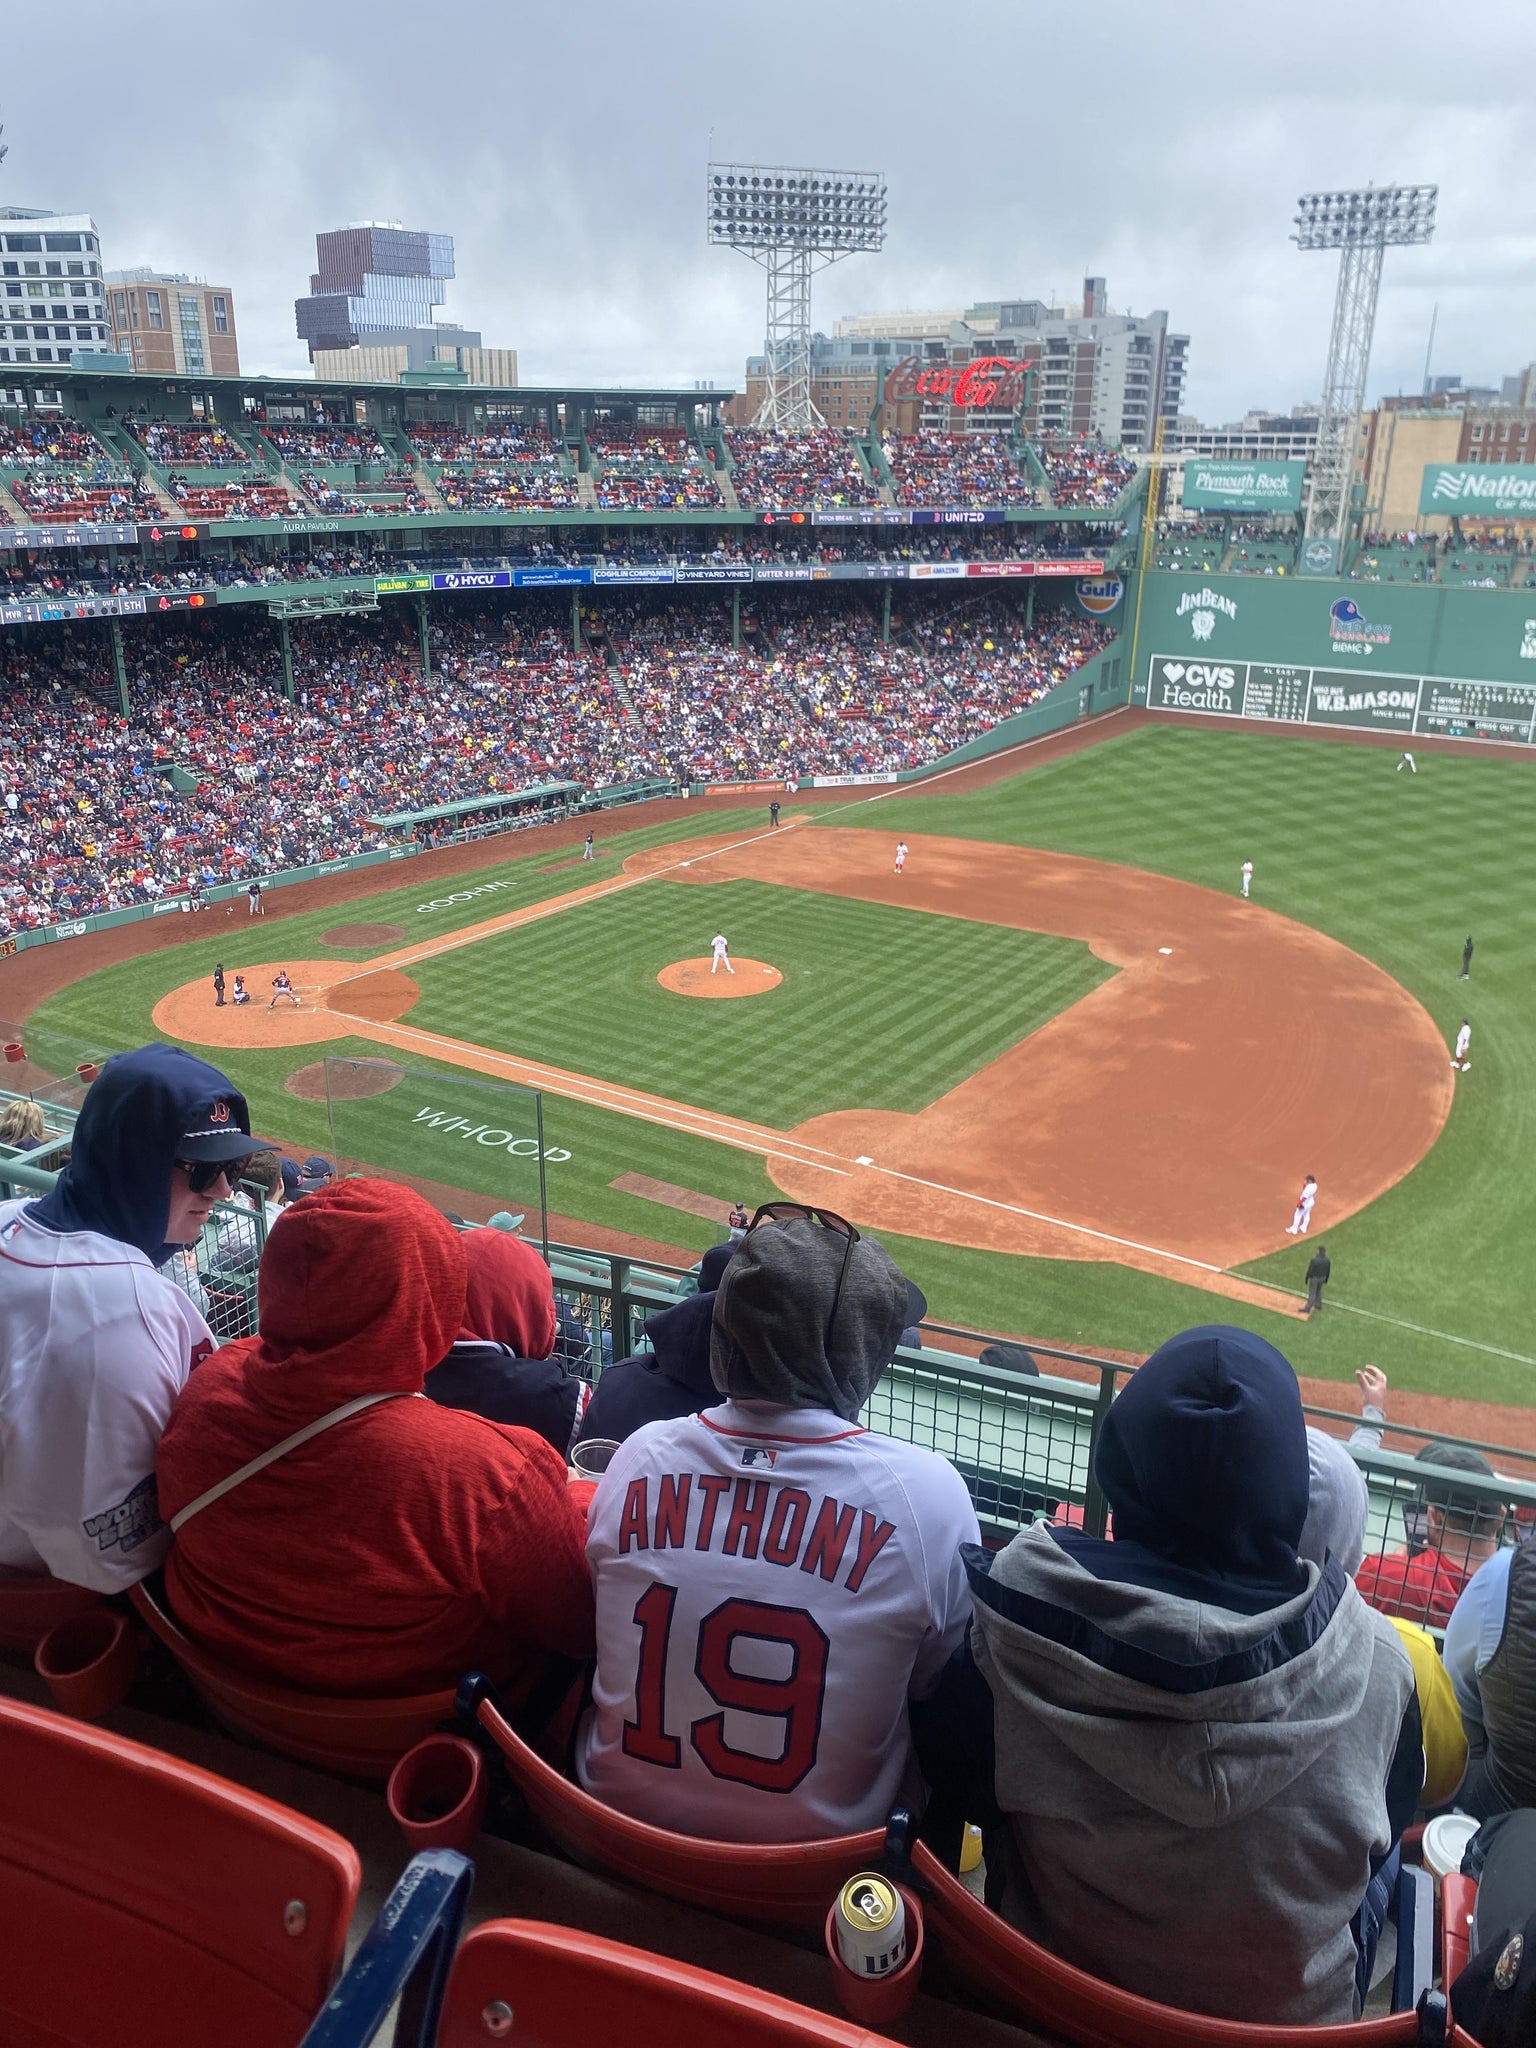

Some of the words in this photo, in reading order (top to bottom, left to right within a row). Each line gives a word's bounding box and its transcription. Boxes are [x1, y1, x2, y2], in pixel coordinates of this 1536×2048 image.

[1195, 472, 1254, 490] Plymouth
[1256, 473, 1289, 490] Rock
[1495, 498, 1516, 510] Car
[945, 512, 985, 522] UNITED
[307, 522, 339, 531] PAVILION
[595, 570, 628, 578] COGHLIN
[757, 569, 784, 578] CUTTER
[784, 568, 794, 577] 89
[795, 568, 809, 577] MPH
[1038, 565, 1070, 574] Safelite
[461, 574, 494, 585] HYCU
[377, 579, 407, 591] SULLIVAN
[415, 579, 429, 588] TIRE
[1078, 580, 1121, 597] Gulf
[47, 603, 65, 611] BALL
[74, 601, 96, 609] STRIKE
[102, 599, 115, 607] OUT
[124, 601, 141, 610] 5TH
[172, 598, 188, 606] prefers
[1175, 592, 1201, 616] JIM
[1202, 587, 1238, 620] BEAM
[5, 610, 22, 619] MVR
[1185, 664, 1235, 690] CVS
[1134, 685, 1146, 694] 310
[1162, 684, 1232, 711] Health
[416, 881, 518, 913] WHOOP
[57, 930, 74, 939] Nine
[411, 1105, 572, 1163] WHOOP
[618, 1472, 897, 1594] ANTHONY
[622, 1580, 831, 1794] 19
[864, 1936, 907, 1974] Lit
